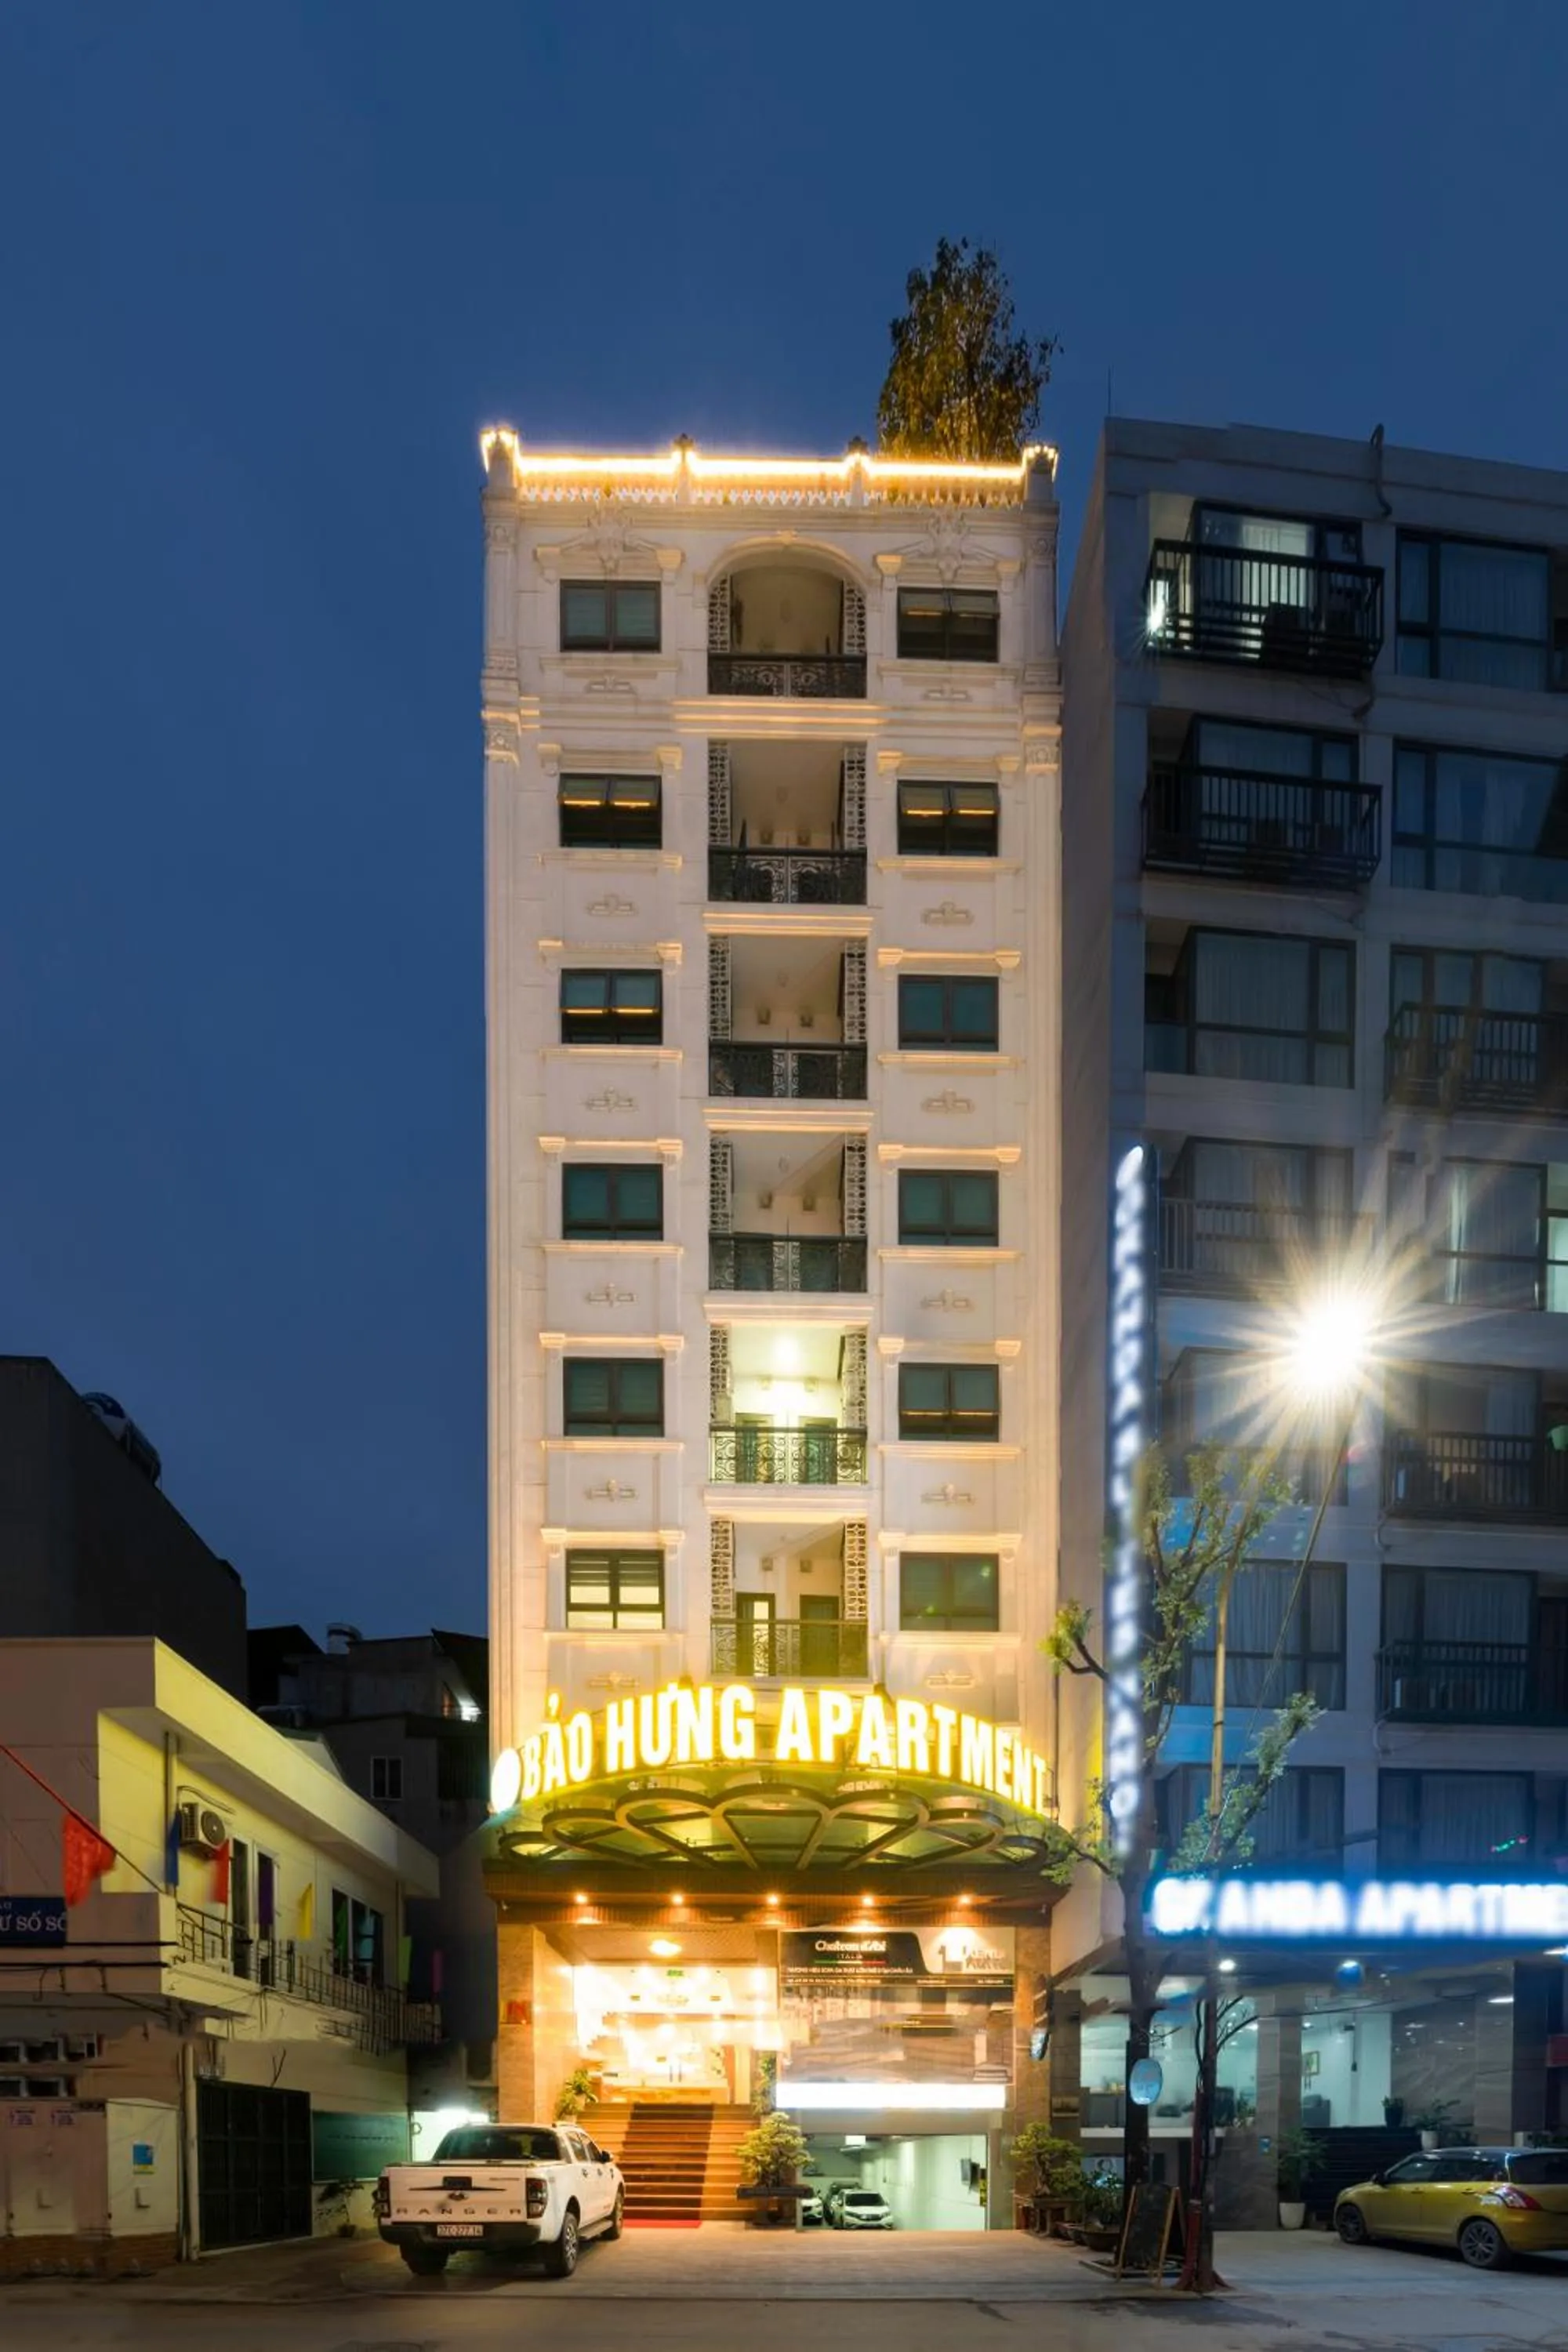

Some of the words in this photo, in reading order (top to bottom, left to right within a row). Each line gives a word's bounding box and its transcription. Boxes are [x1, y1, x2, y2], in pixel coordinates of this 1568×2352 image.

[521, 1692, 593, 1802] BẢO
[604, 1682, 756, 1774] HƯNG
[775, 1687, 1047, 1817] APARTMENT
[396, 2207, 522, 2216] RANGER
